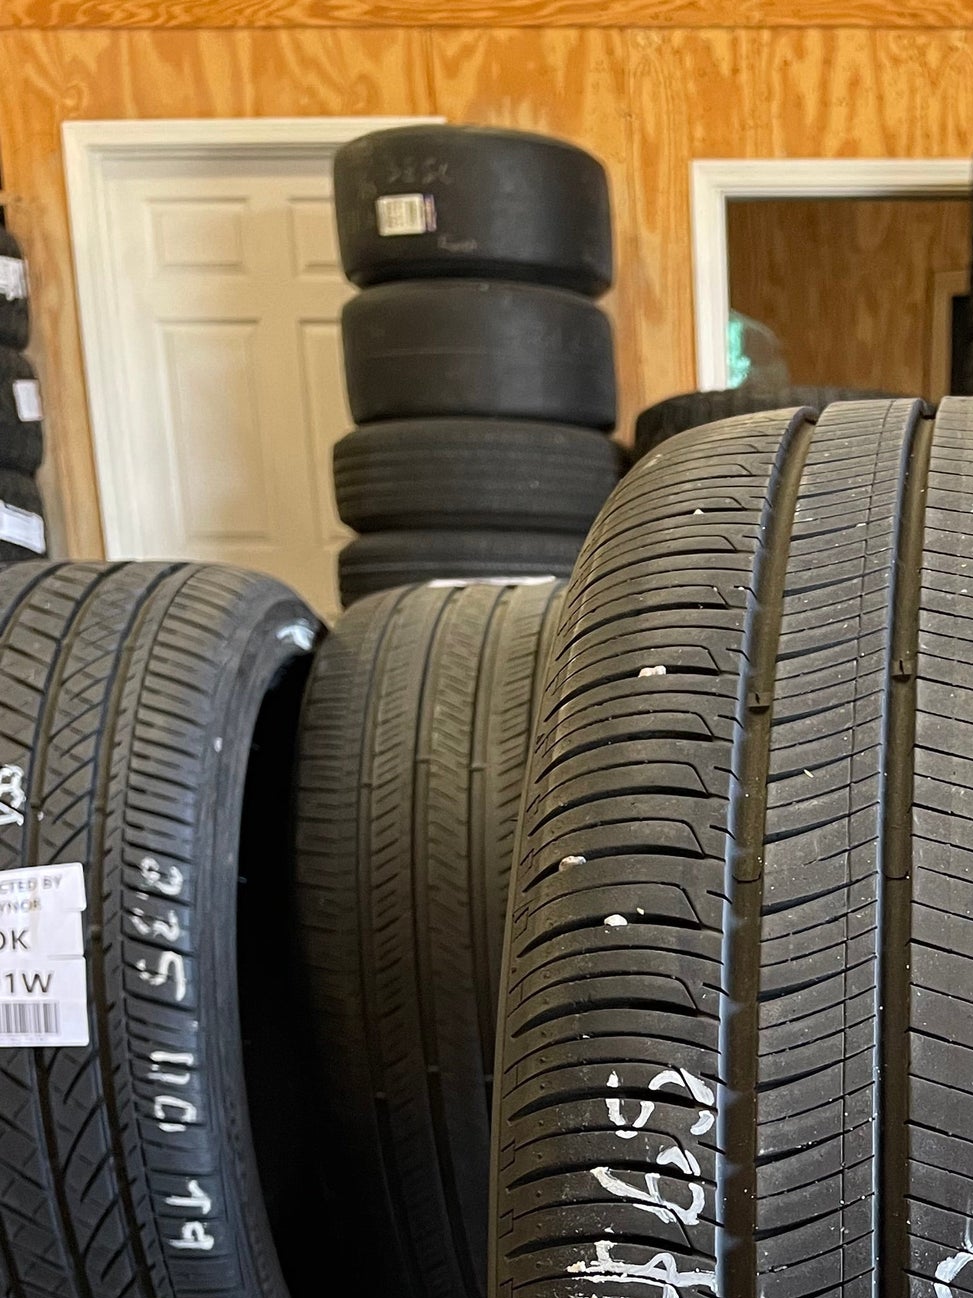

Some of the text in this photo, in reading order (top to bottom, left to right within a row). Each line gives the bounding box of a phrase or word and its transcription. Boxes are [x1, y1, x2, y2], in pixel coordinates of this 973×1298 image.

[42, 875, 63, 890] BY
[131, 858, 188, 1000] 235
[169, 1178, 215, 1252] 19
